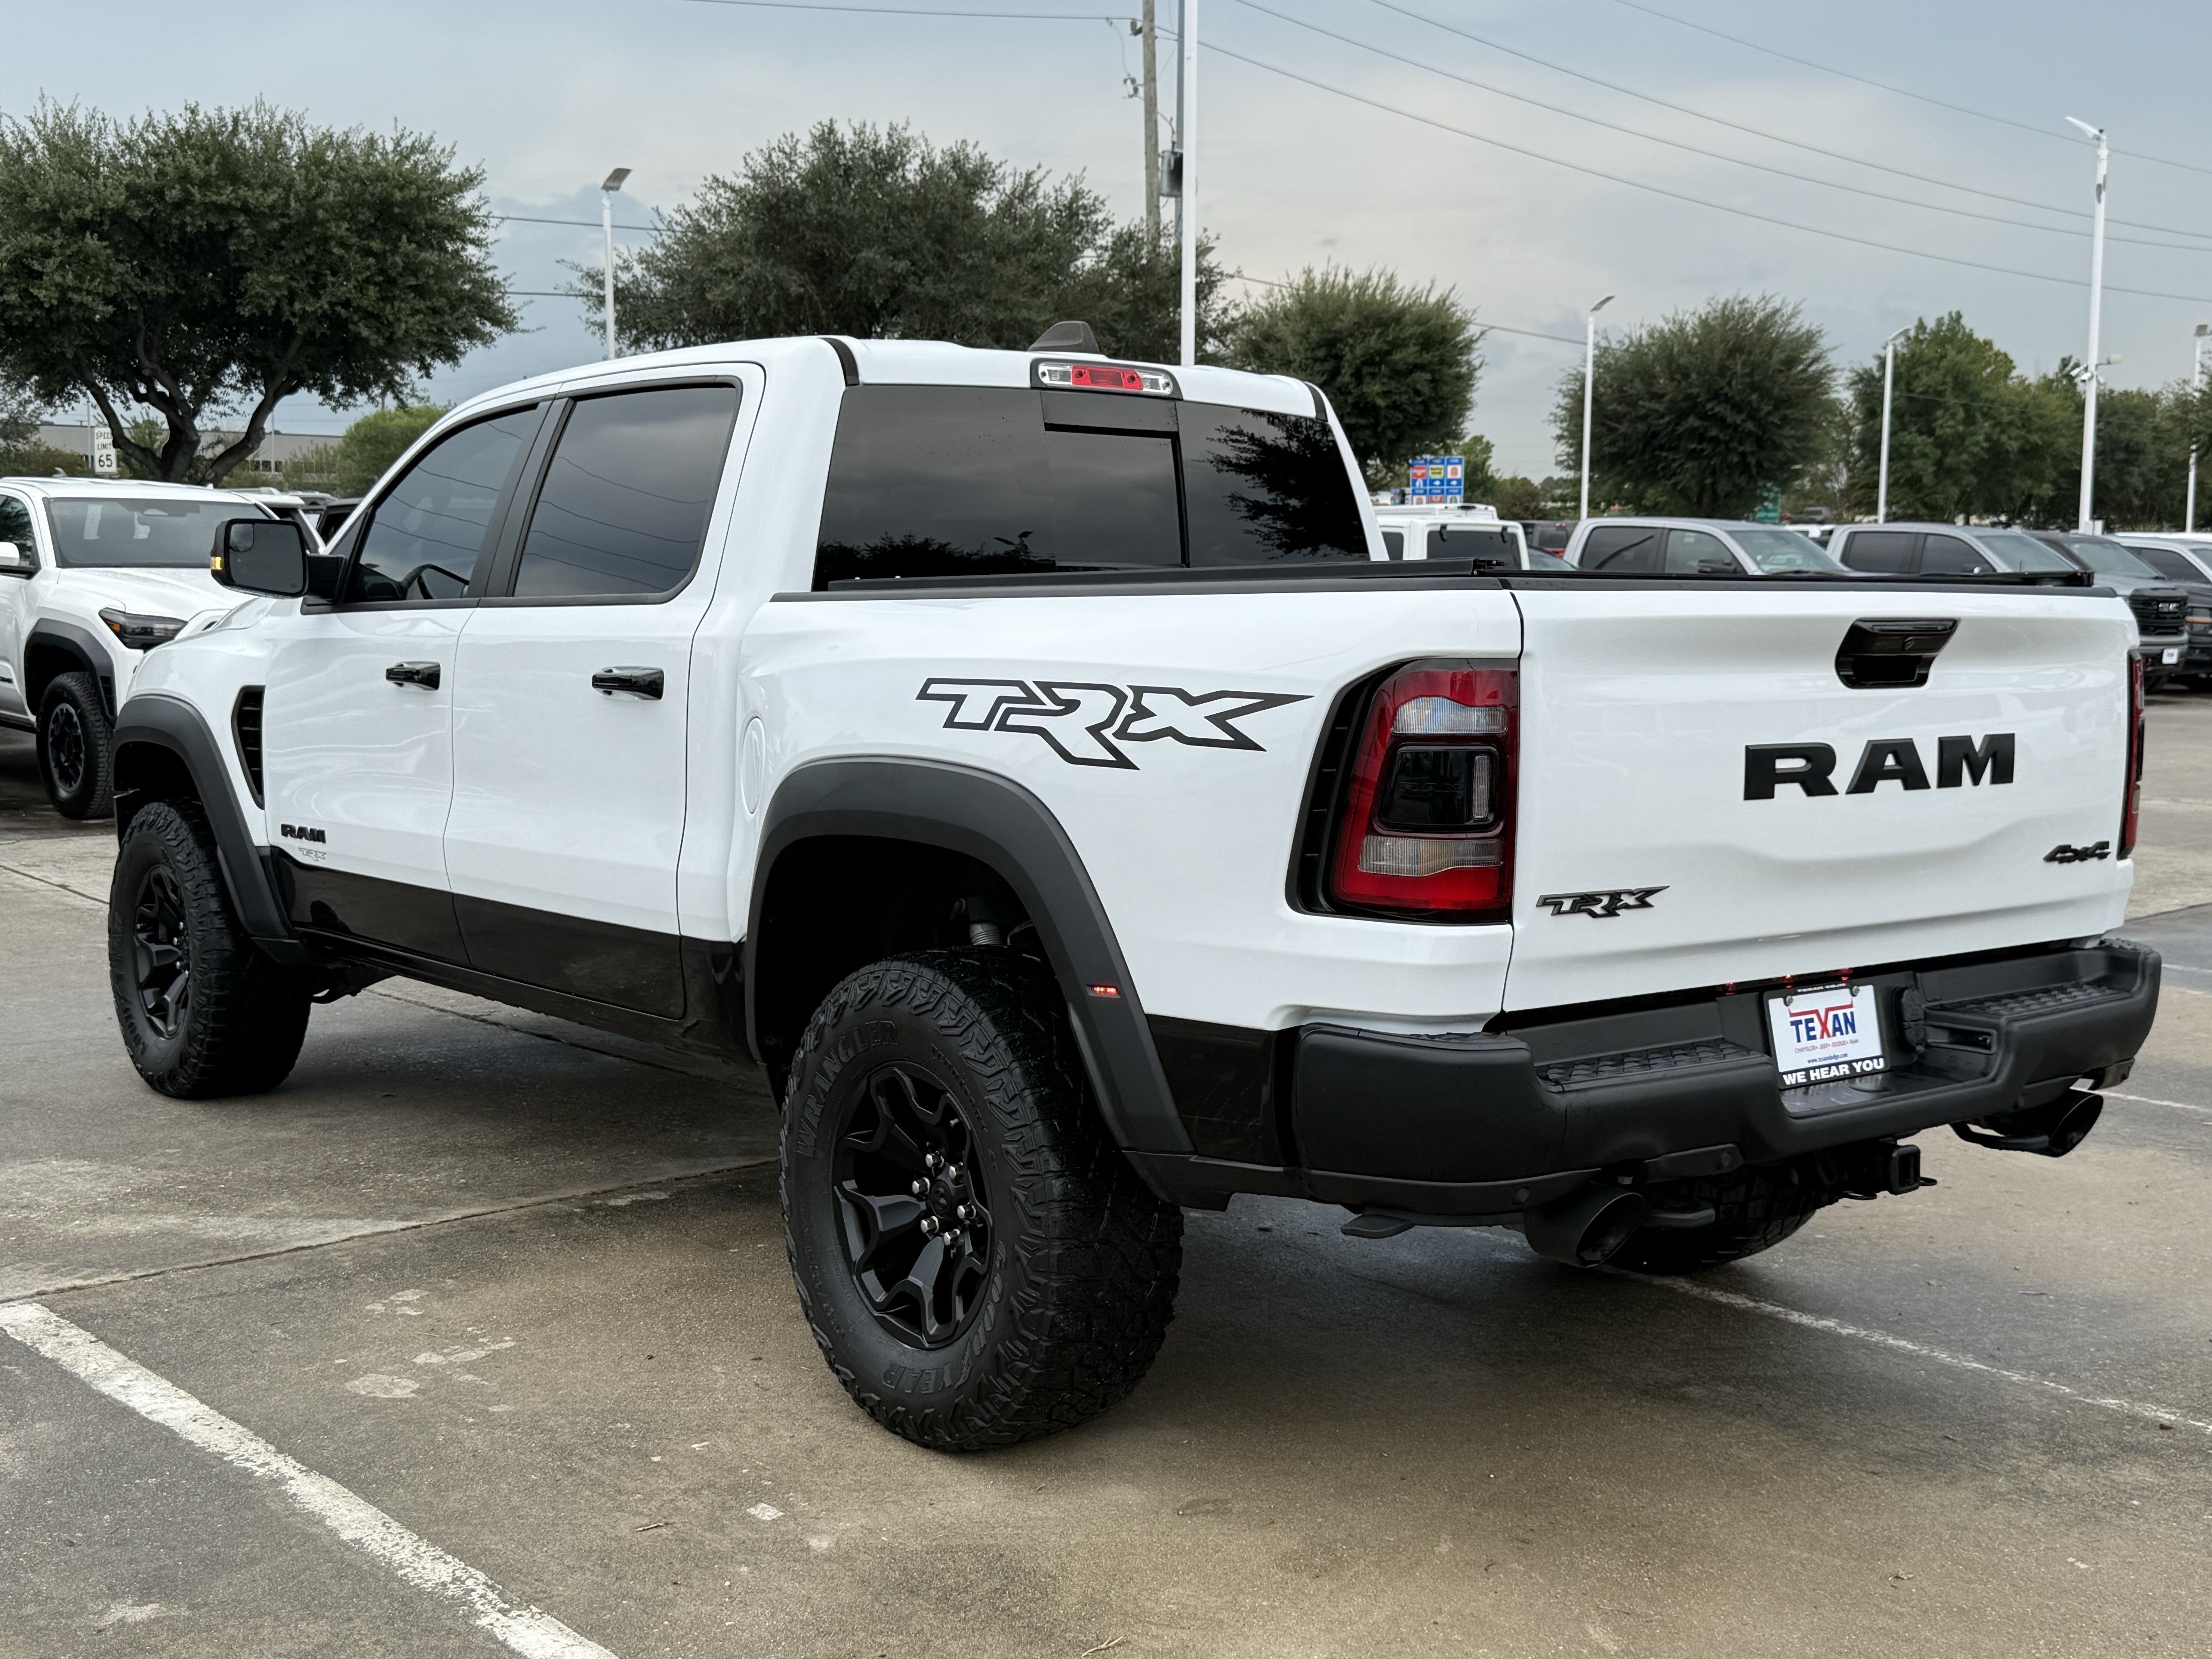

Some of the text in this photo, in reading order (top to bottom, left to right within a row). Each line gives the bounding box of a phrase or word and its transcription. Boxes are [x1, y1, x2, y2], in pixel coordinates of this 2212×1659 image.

[98, 454, 113, 468] 65
[915, 678, 1315, 771] TRX
[1743, 733, 2015, 801] RAM
[1398, 781, 1463, 793] RAM
[281, 823, 326, 844] RAM
[298, 847, 327, 862] TRX
[1535, 885, 1670, 919] TRX
[1788, 1007, 1856, 1043] TEXAN
[1783, 1057, 1884, 1085] WE HEAR YOU
[796, 1020, 899, 1158] WRANGLER
[882, 1240, 1006, 1394] GOODYEAR
